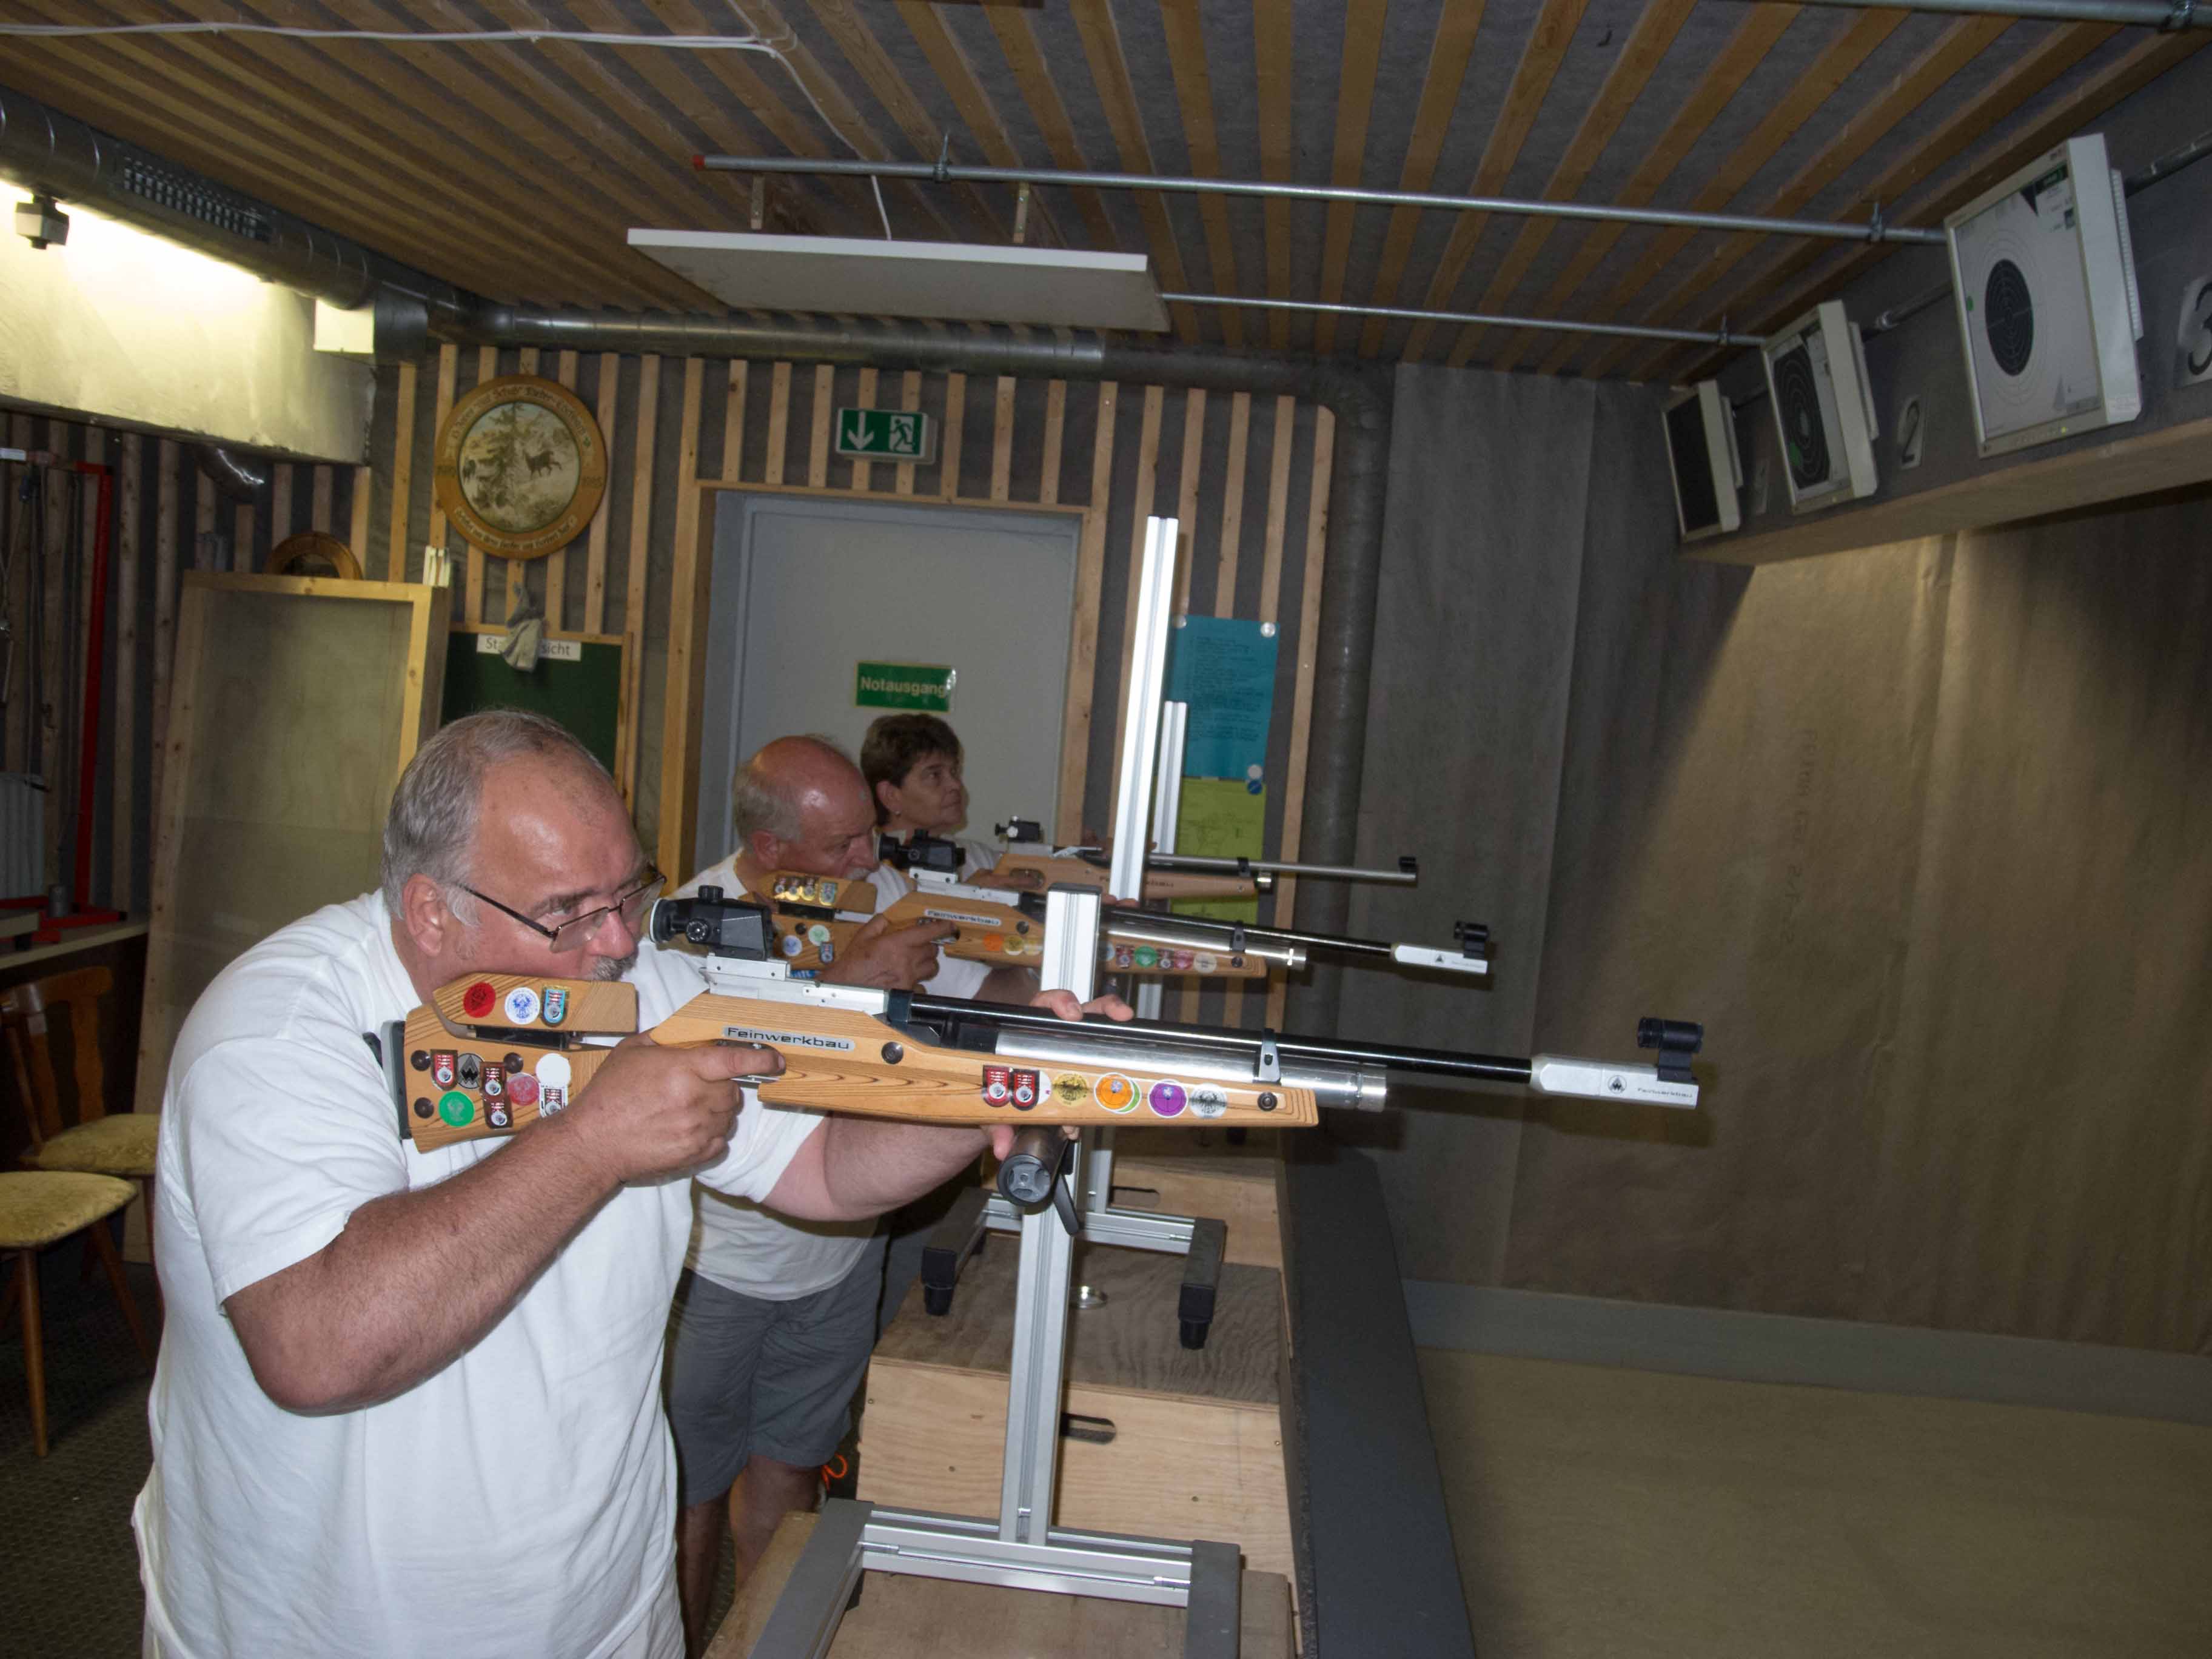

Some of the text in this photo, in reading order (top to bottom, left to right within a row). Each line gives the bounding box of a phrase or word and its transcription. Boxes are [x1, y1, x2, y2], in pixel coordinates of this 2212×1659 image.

[1902, 401, 1920, 463] 2
[860, 677, 947, 699] Notausgang
[727, 1027, 850, 1050] Feinwerkbau
